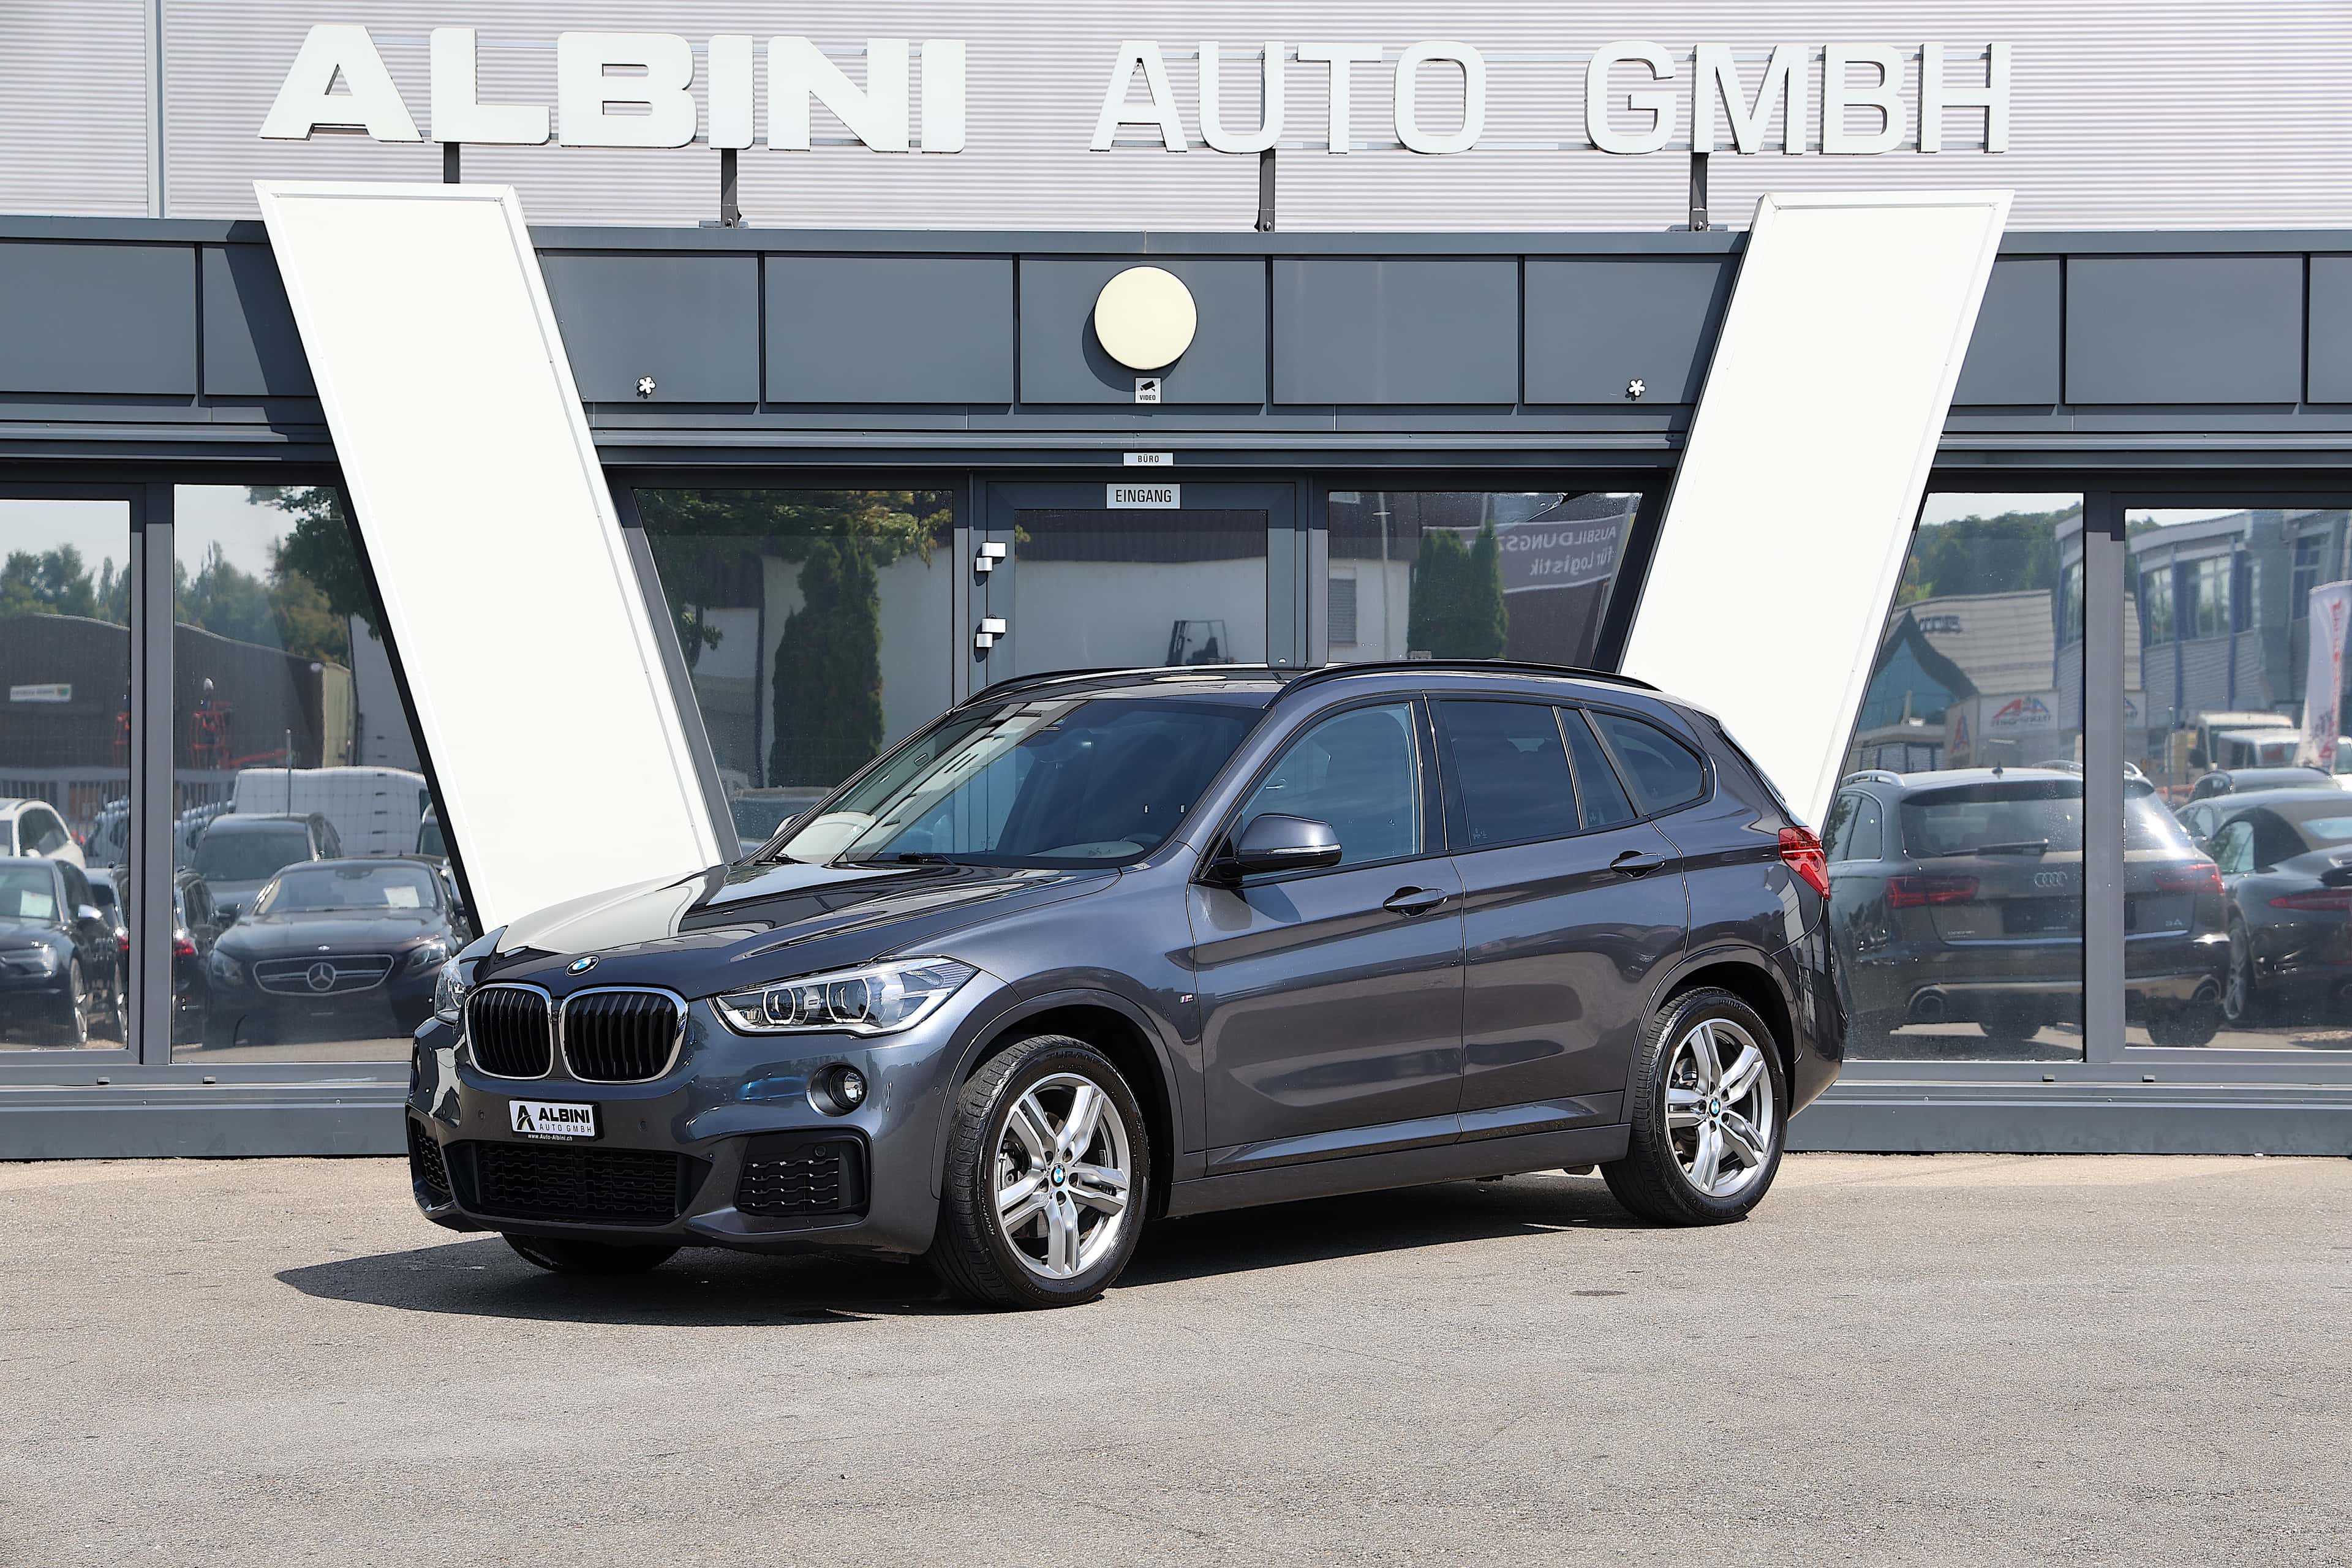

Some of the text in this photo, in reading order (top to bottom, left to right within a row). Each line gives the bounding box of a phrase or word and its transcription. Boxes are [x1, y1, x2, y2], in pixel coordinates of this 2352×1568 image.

[257, 24, 2012, 156] ALBINI AUTO GMBH
[1137, 454, 1159, 462] BÜRO
[1115, 489, 1172, 503] EINGANG
[538, 1107, 590, 1123] ALBINI
